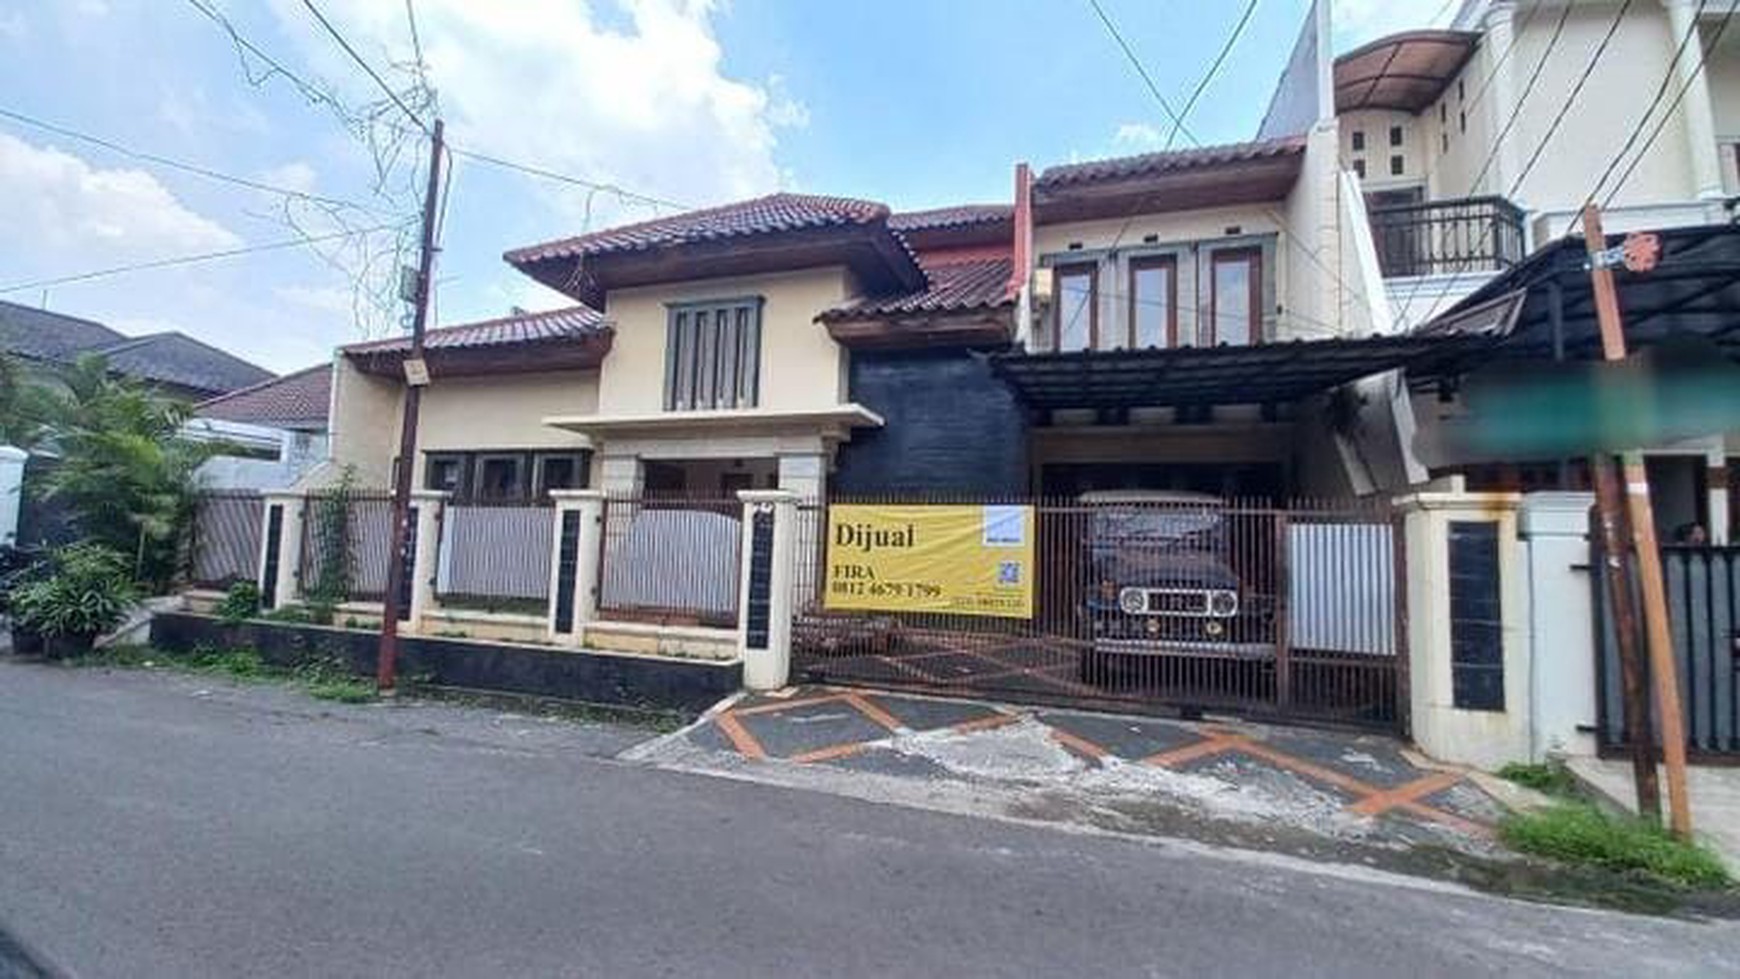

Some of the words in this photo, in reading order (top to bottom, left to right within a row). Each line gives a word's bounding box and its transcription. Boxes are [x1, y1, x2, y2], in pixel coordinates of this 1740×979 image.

[835, 524, 915, 552] Dijual
[834, 566, 874, 580] FIRA
[832, 581, 864, 595] 0812
